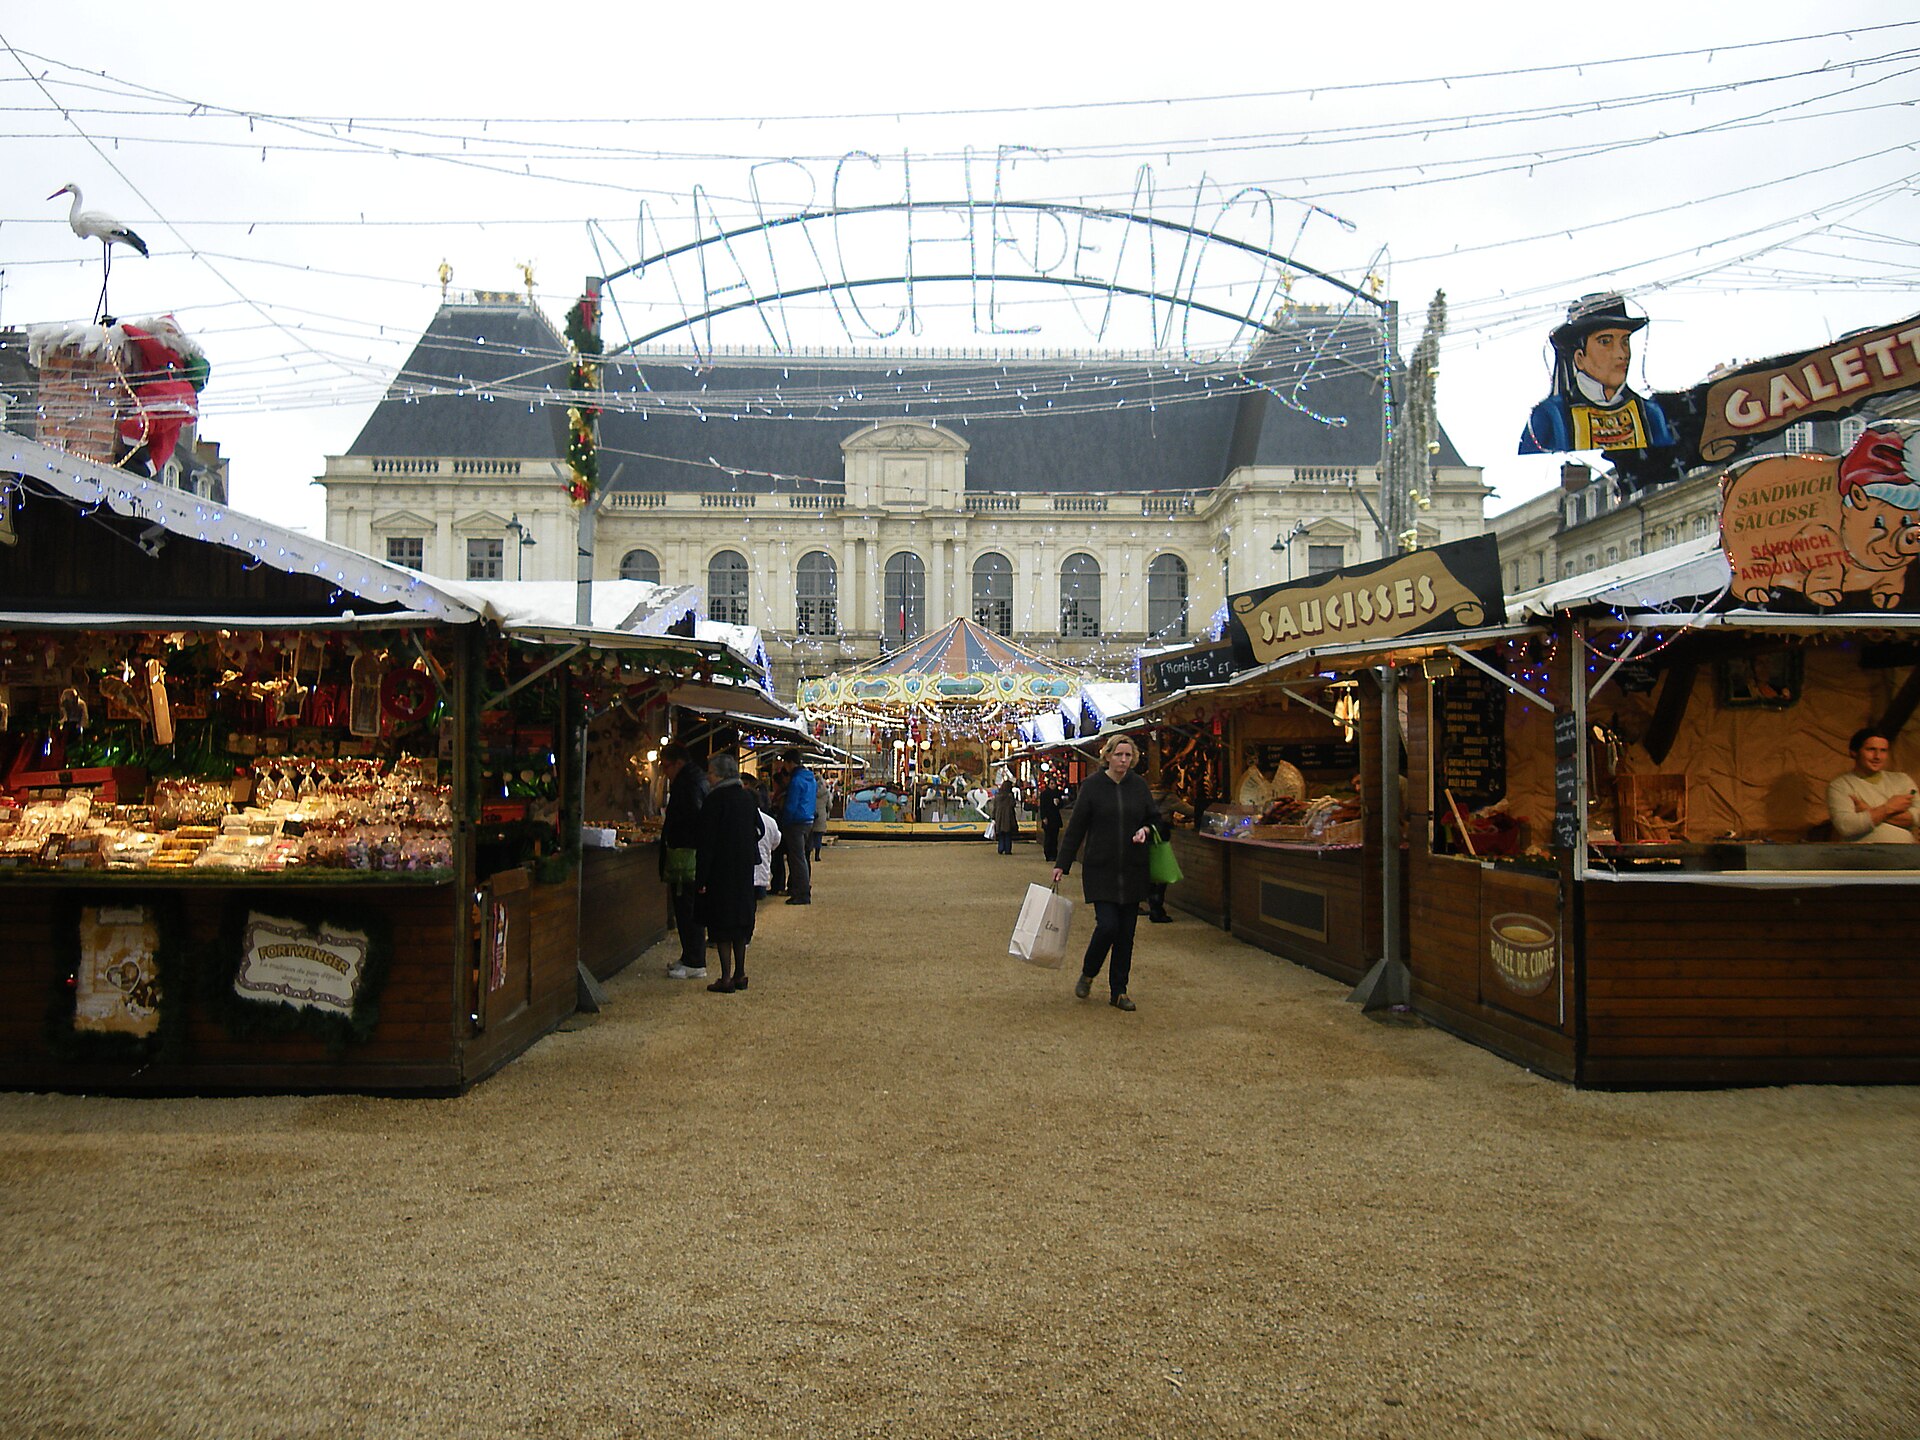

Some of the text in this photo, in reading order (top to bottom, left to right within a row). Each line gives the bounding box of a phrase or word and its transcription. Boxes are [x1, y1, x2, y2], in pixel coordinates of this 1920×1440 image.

[1034, 206, 1112, 282] DE
[1736, 475, 1833, 510] SANDWICH
[1733, 501, 1820, 534] SAUCISSE
[1750, 534, 1832, 560] SANDWICH
[1259, 574, 1437, 645] SAUCISSES
[1159, 658, 1231, 677] FROMAGES ET
[257, 943, 351, 977] FORTWENGER
[1516, 951, 1528, 979] DE
[1530, 946, 1556, 978] CIDRE
